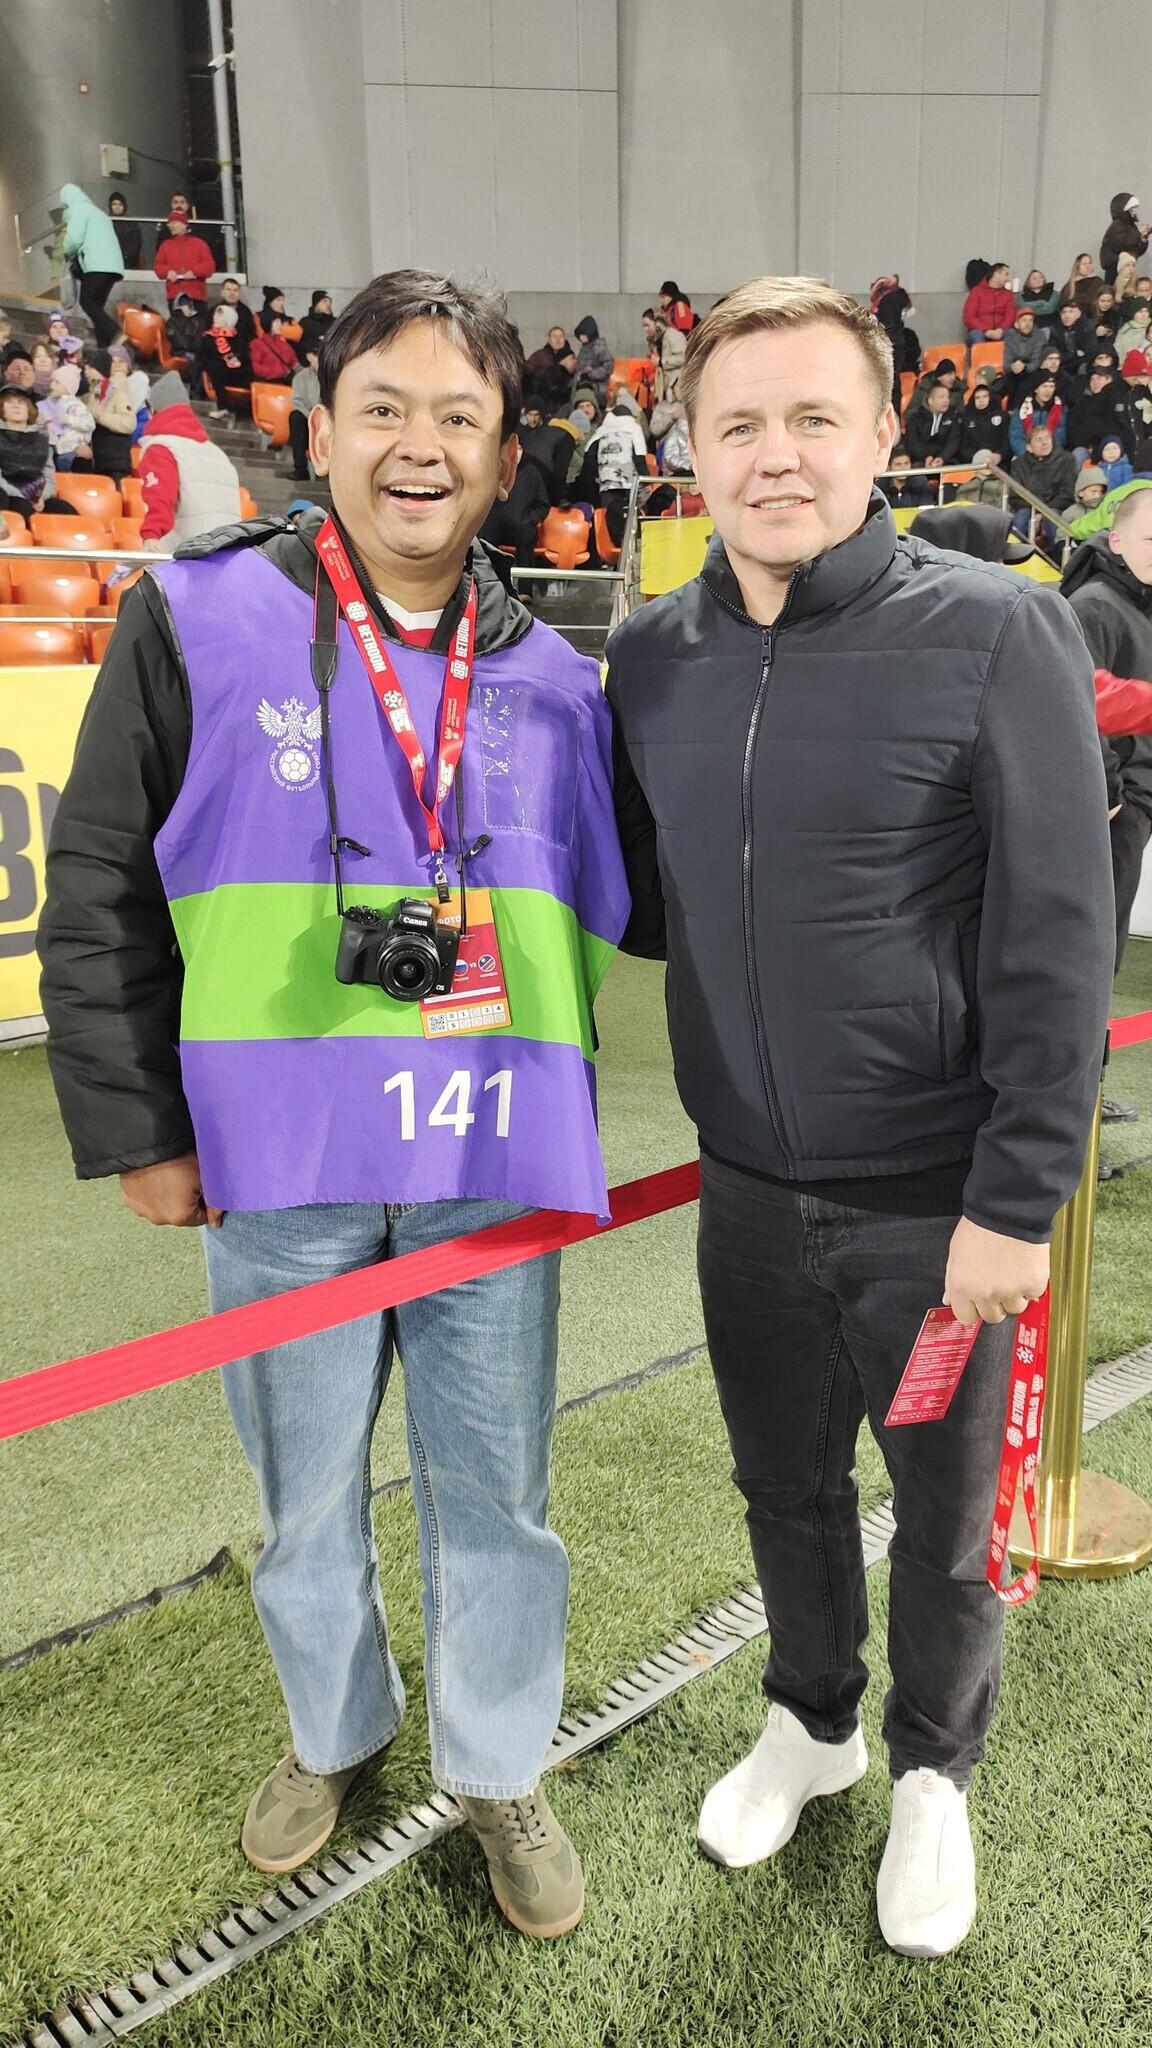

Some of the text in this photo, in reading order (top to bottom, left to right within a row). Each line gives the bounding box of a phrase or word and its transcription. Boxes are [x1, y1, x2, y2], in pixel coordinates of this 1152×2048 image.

[357, 624, 387, 673] BETBOOM
[455, 617, 470, 658] BETBOOM
[403, 916, 428, 927] Canon
[384, 1069, 512, 1140] 141
[1011, 1379, 1027, 1426] BETBOOM
